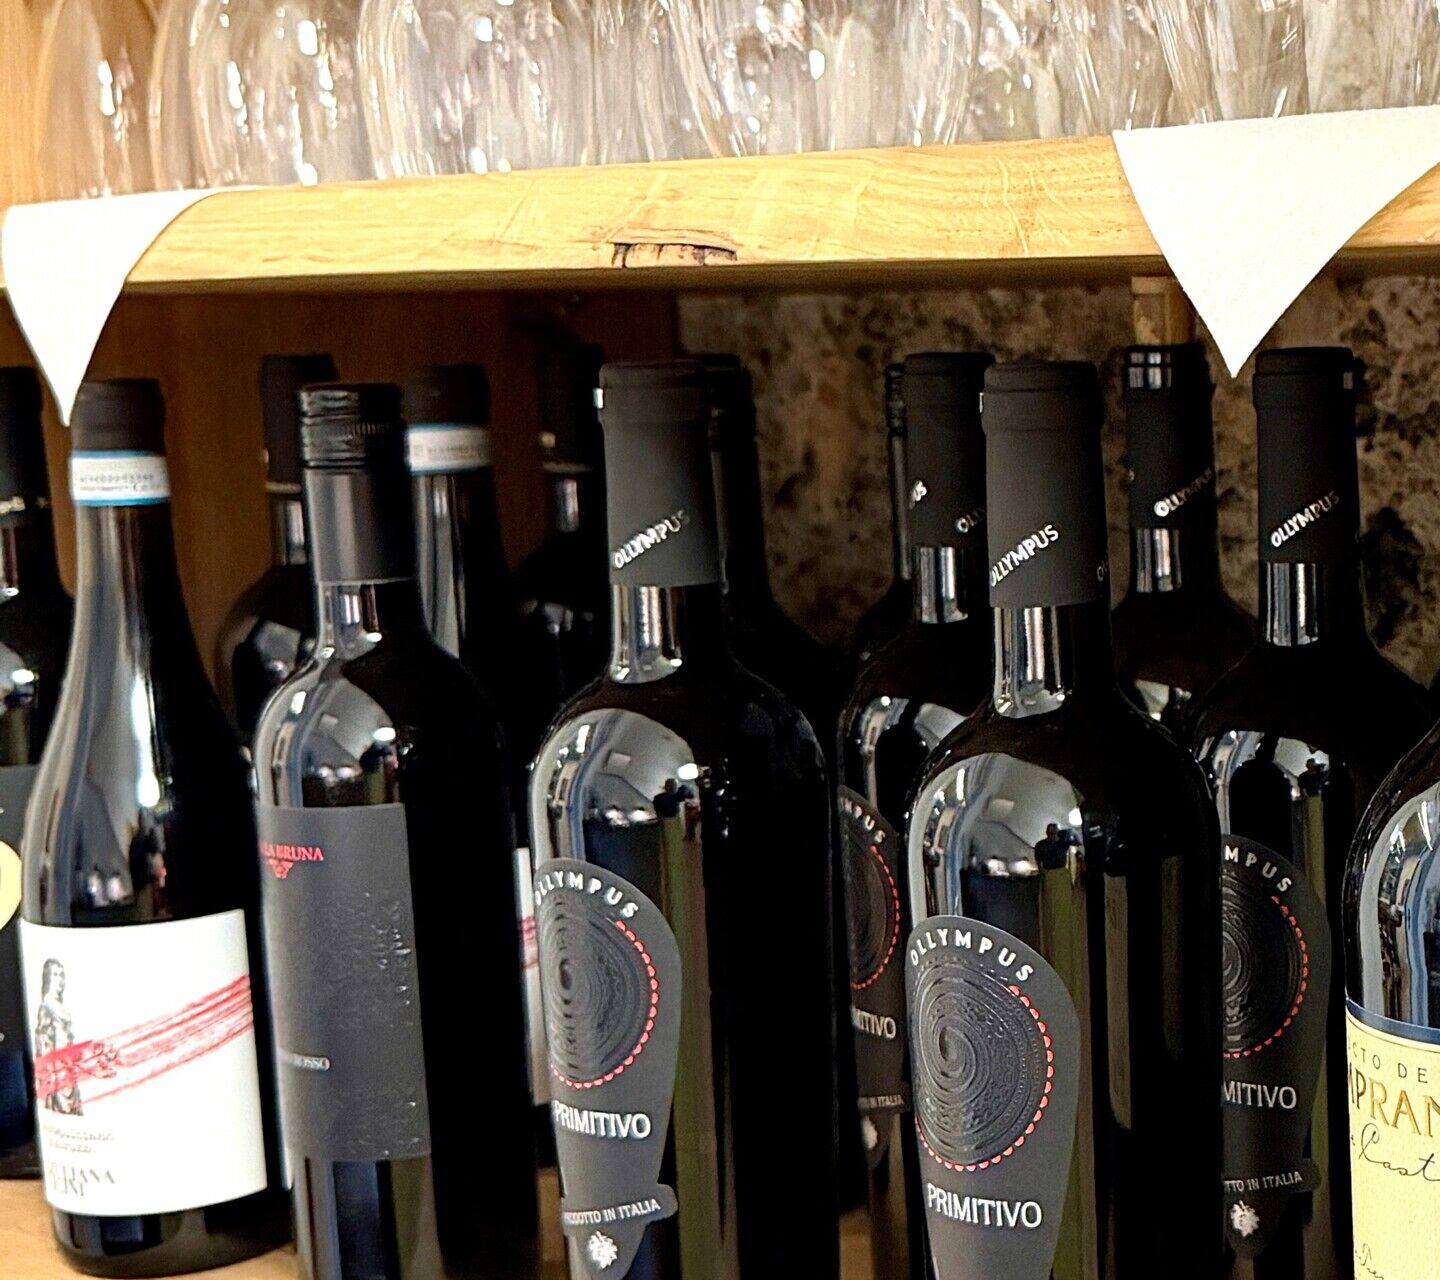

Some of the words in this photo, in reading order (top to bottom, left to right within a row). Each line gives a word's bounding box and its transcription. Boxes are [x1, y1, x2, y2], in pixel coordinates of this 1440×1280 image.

[1270, 490, 1341, 548] OLLYMPUS
[1224, 845, 1293, 892] MPUS
[534, 870, 640, 919] OLLYMPUS
[910, 928, 1035, 982] OLLYMPUS
[1397, 1062, 1429, 1084] DE
[552, 1099, 652, 1139] PRIMITIVO
[1262, 1171, 1303, 1189] ITALIA
[603, 1207, 617, 1223] IN
[619, 1198, 662, 1220] ITALIA
[926, 1181, 1043, 1229] PRIMITIVO
